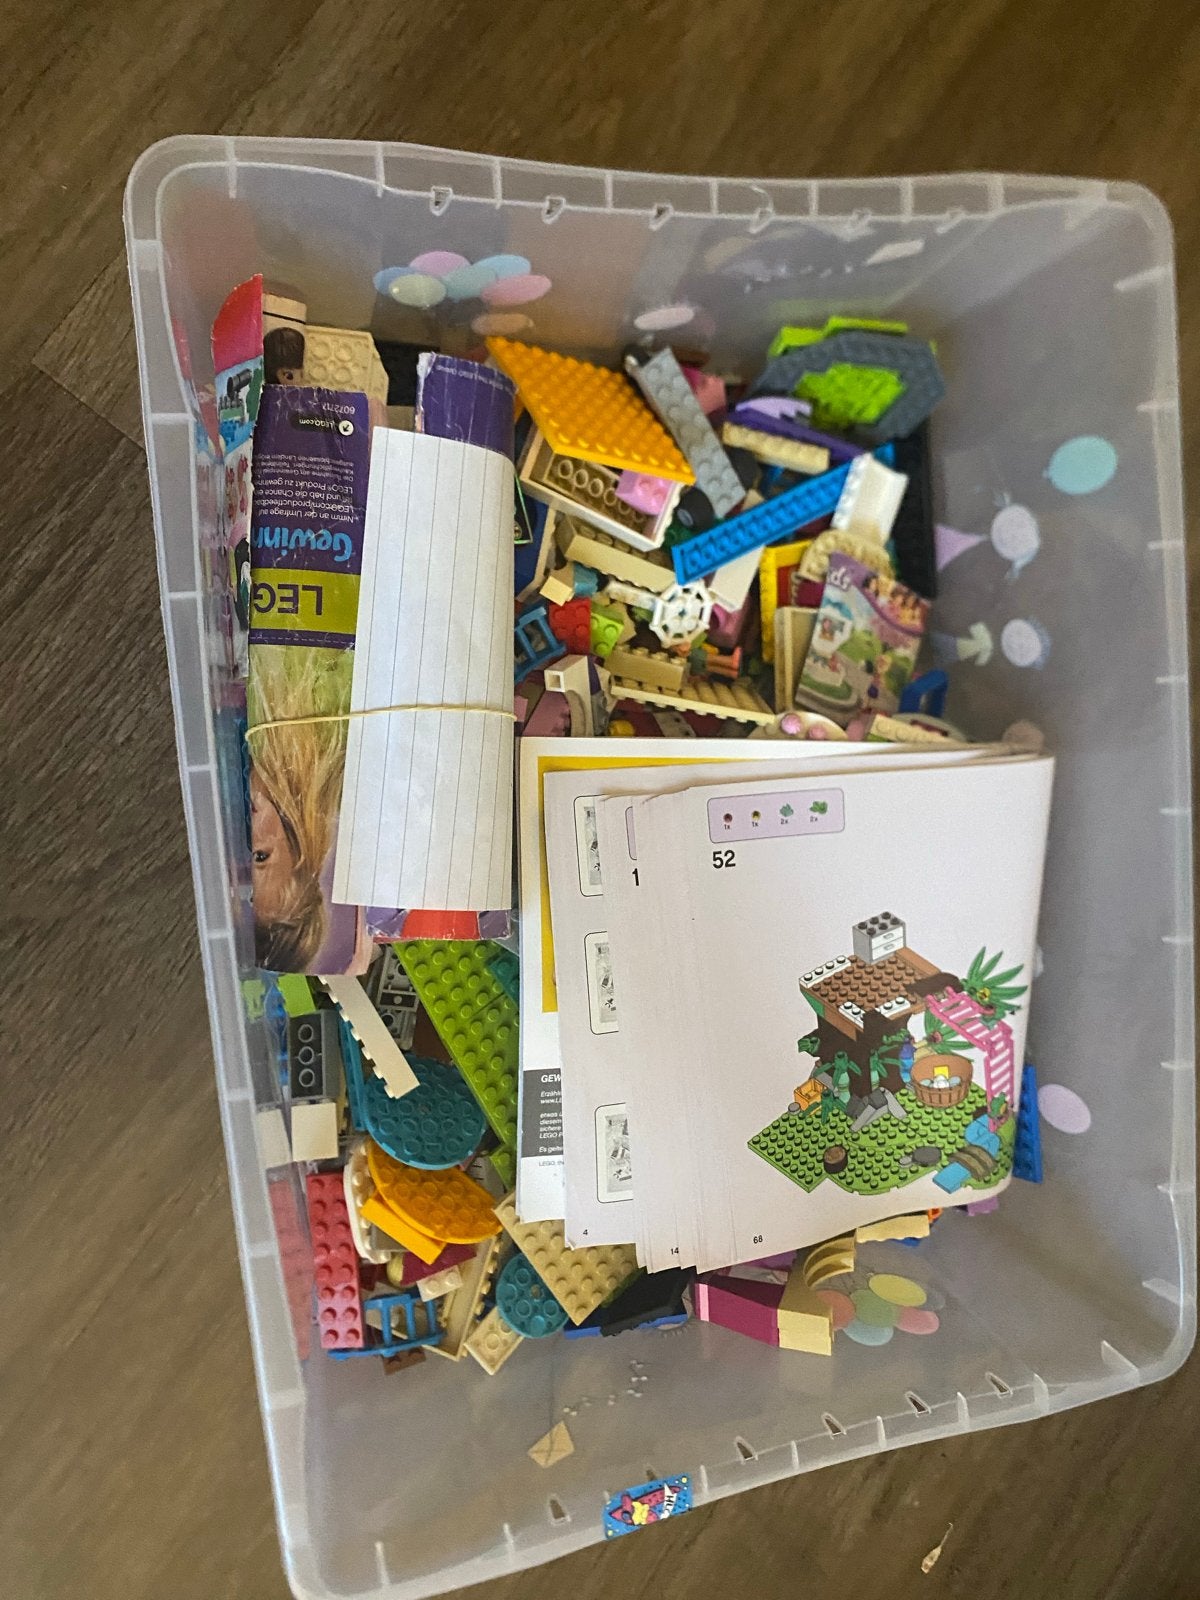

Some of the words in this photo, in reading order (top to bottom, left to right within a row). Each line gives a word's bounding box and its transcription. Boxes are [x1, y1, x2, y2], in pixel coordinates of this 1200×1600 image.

[295, 480, 327, 491] Produkt
[265, 489, 294, 498] Chance
[295, 490, 308, 498] die
[326, 493, 341, 501] und
[269, 507, 303, 518] Umfrage
[331, 514, 354, 523] Nimm
[711, 850, 736, 869] 52
[753, 1234, 763, 1244] 68
[670, 1247, 680, 1255] 14
